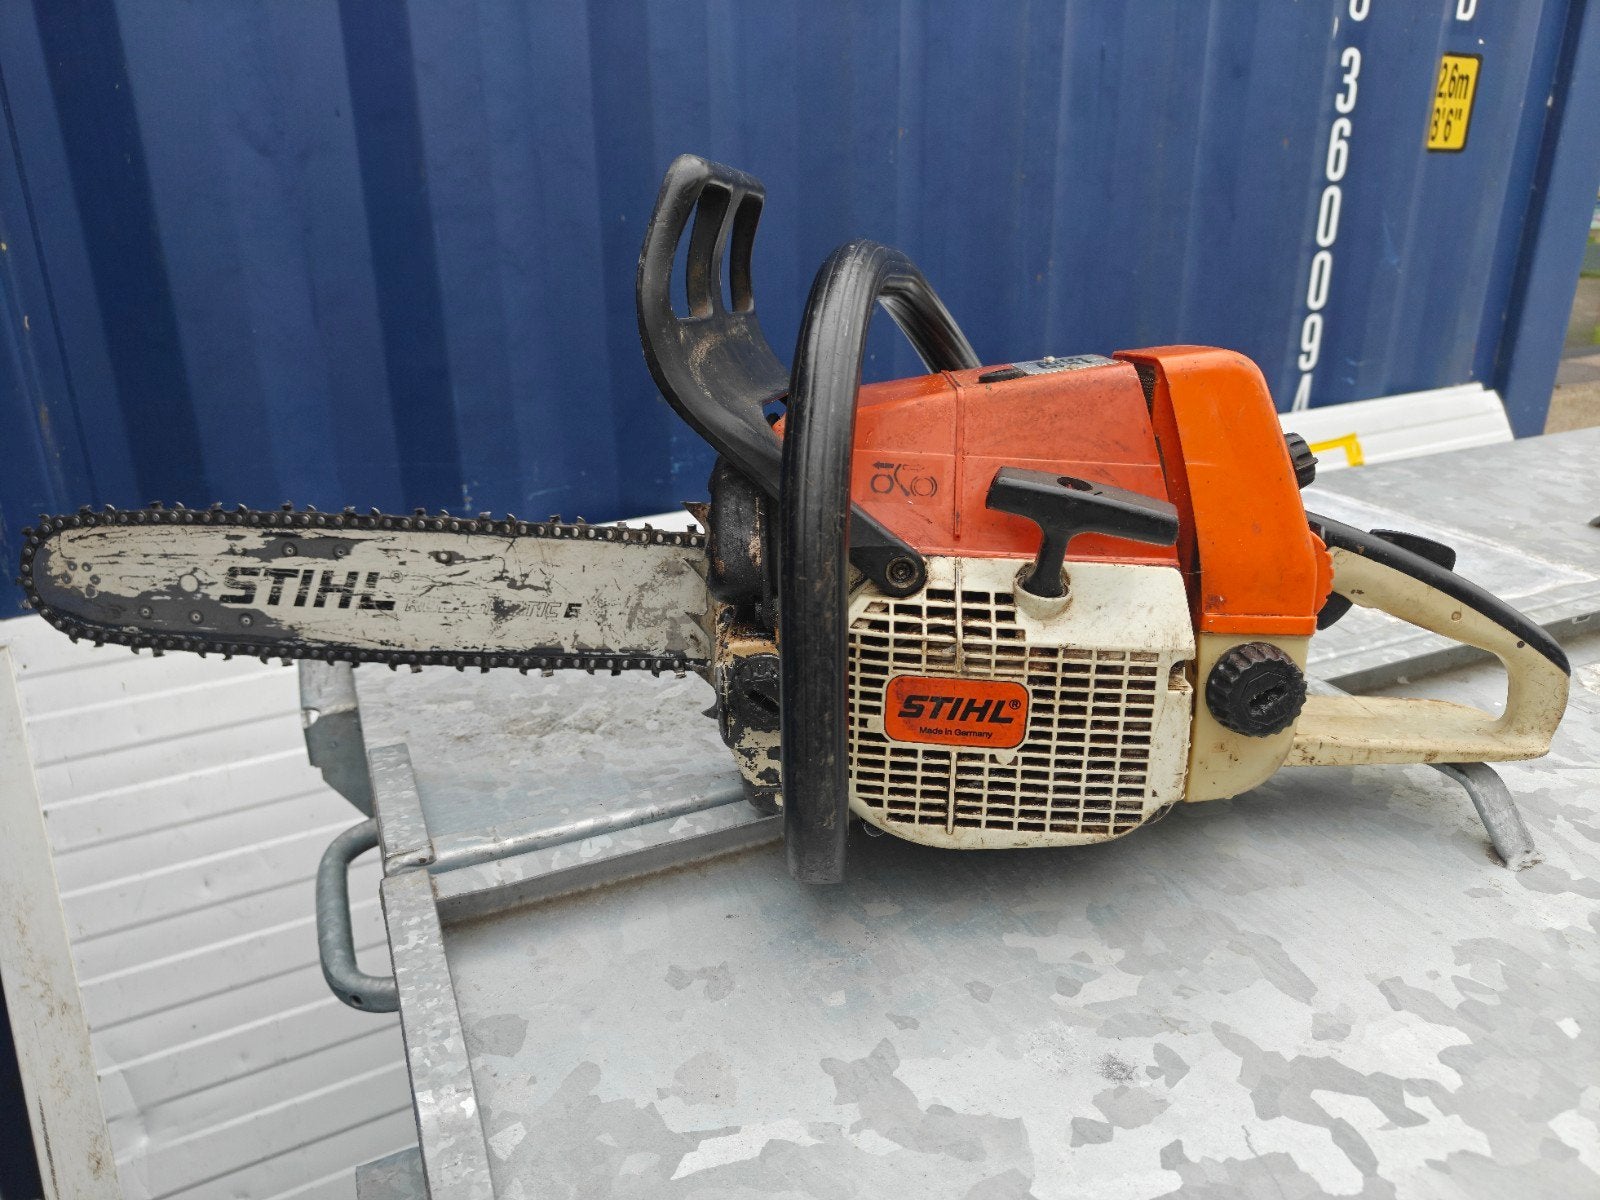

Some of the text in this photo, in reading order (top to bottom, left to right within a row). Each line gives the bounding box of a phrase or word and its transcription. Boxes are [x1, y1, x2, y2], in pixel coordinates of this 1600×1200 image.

[219, 566, 396, 611] STIHL
[919, 726, 943, 736] Made
[954, 729, 993, 739] Germany
